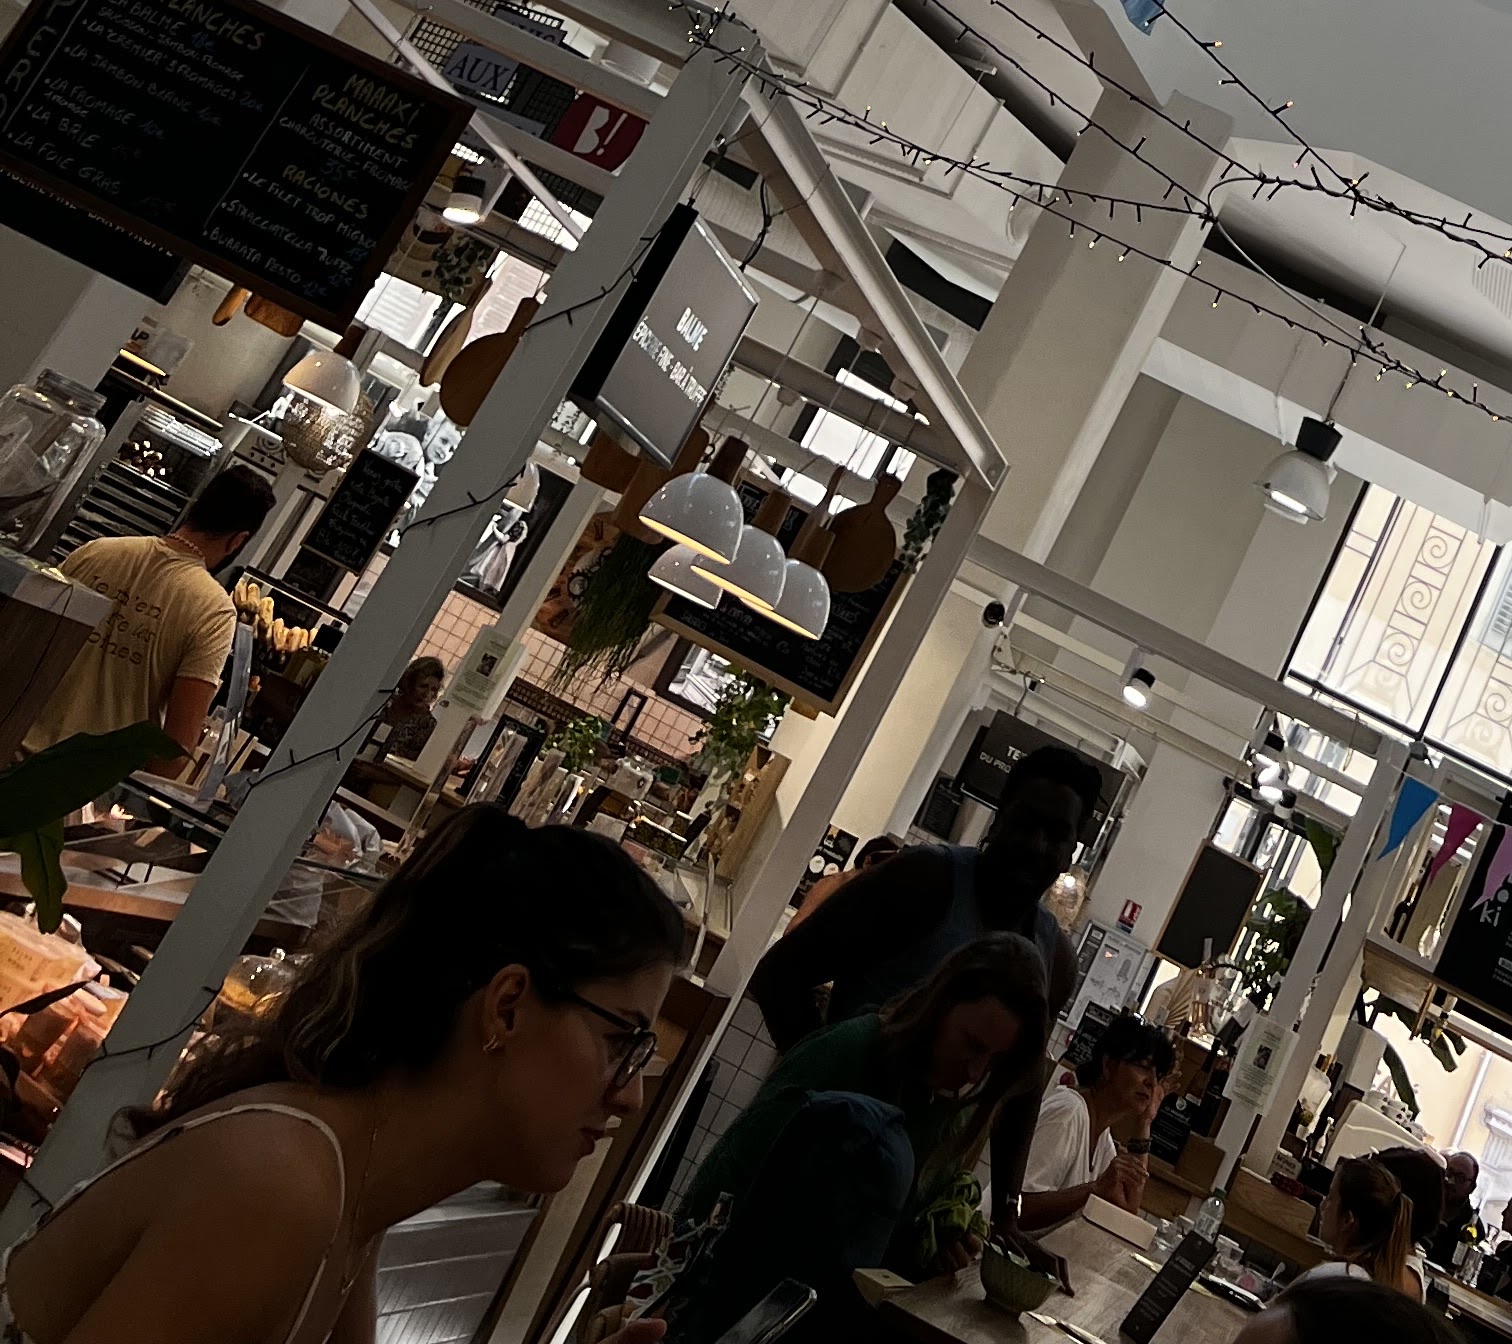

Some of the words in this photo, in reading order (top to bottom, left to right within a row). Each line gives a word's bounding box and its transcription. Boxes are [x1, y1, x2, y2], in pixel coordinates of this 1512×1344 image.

[130, 1, 187, 36] BALME
[92, 54, 144, 89] JAMBON
[448, 54, 509, 92] AUX
[69, 85, 136, 125] FROMAGE
[312, 84, 417, 149] PLANCHES
[32, 106, 50, 124] LA
[58, 118, 101, 148] BRIE
[309, 114, 408, 169] ASSORTIMENT
[14, 132, 35, 149] LA
[37, 143, 76, 170] FOIE
[78, 167, 121, 196] GRAS
[209, 227, 262, 263] BURRATA
[265, 253, 301, 284] PESTO
